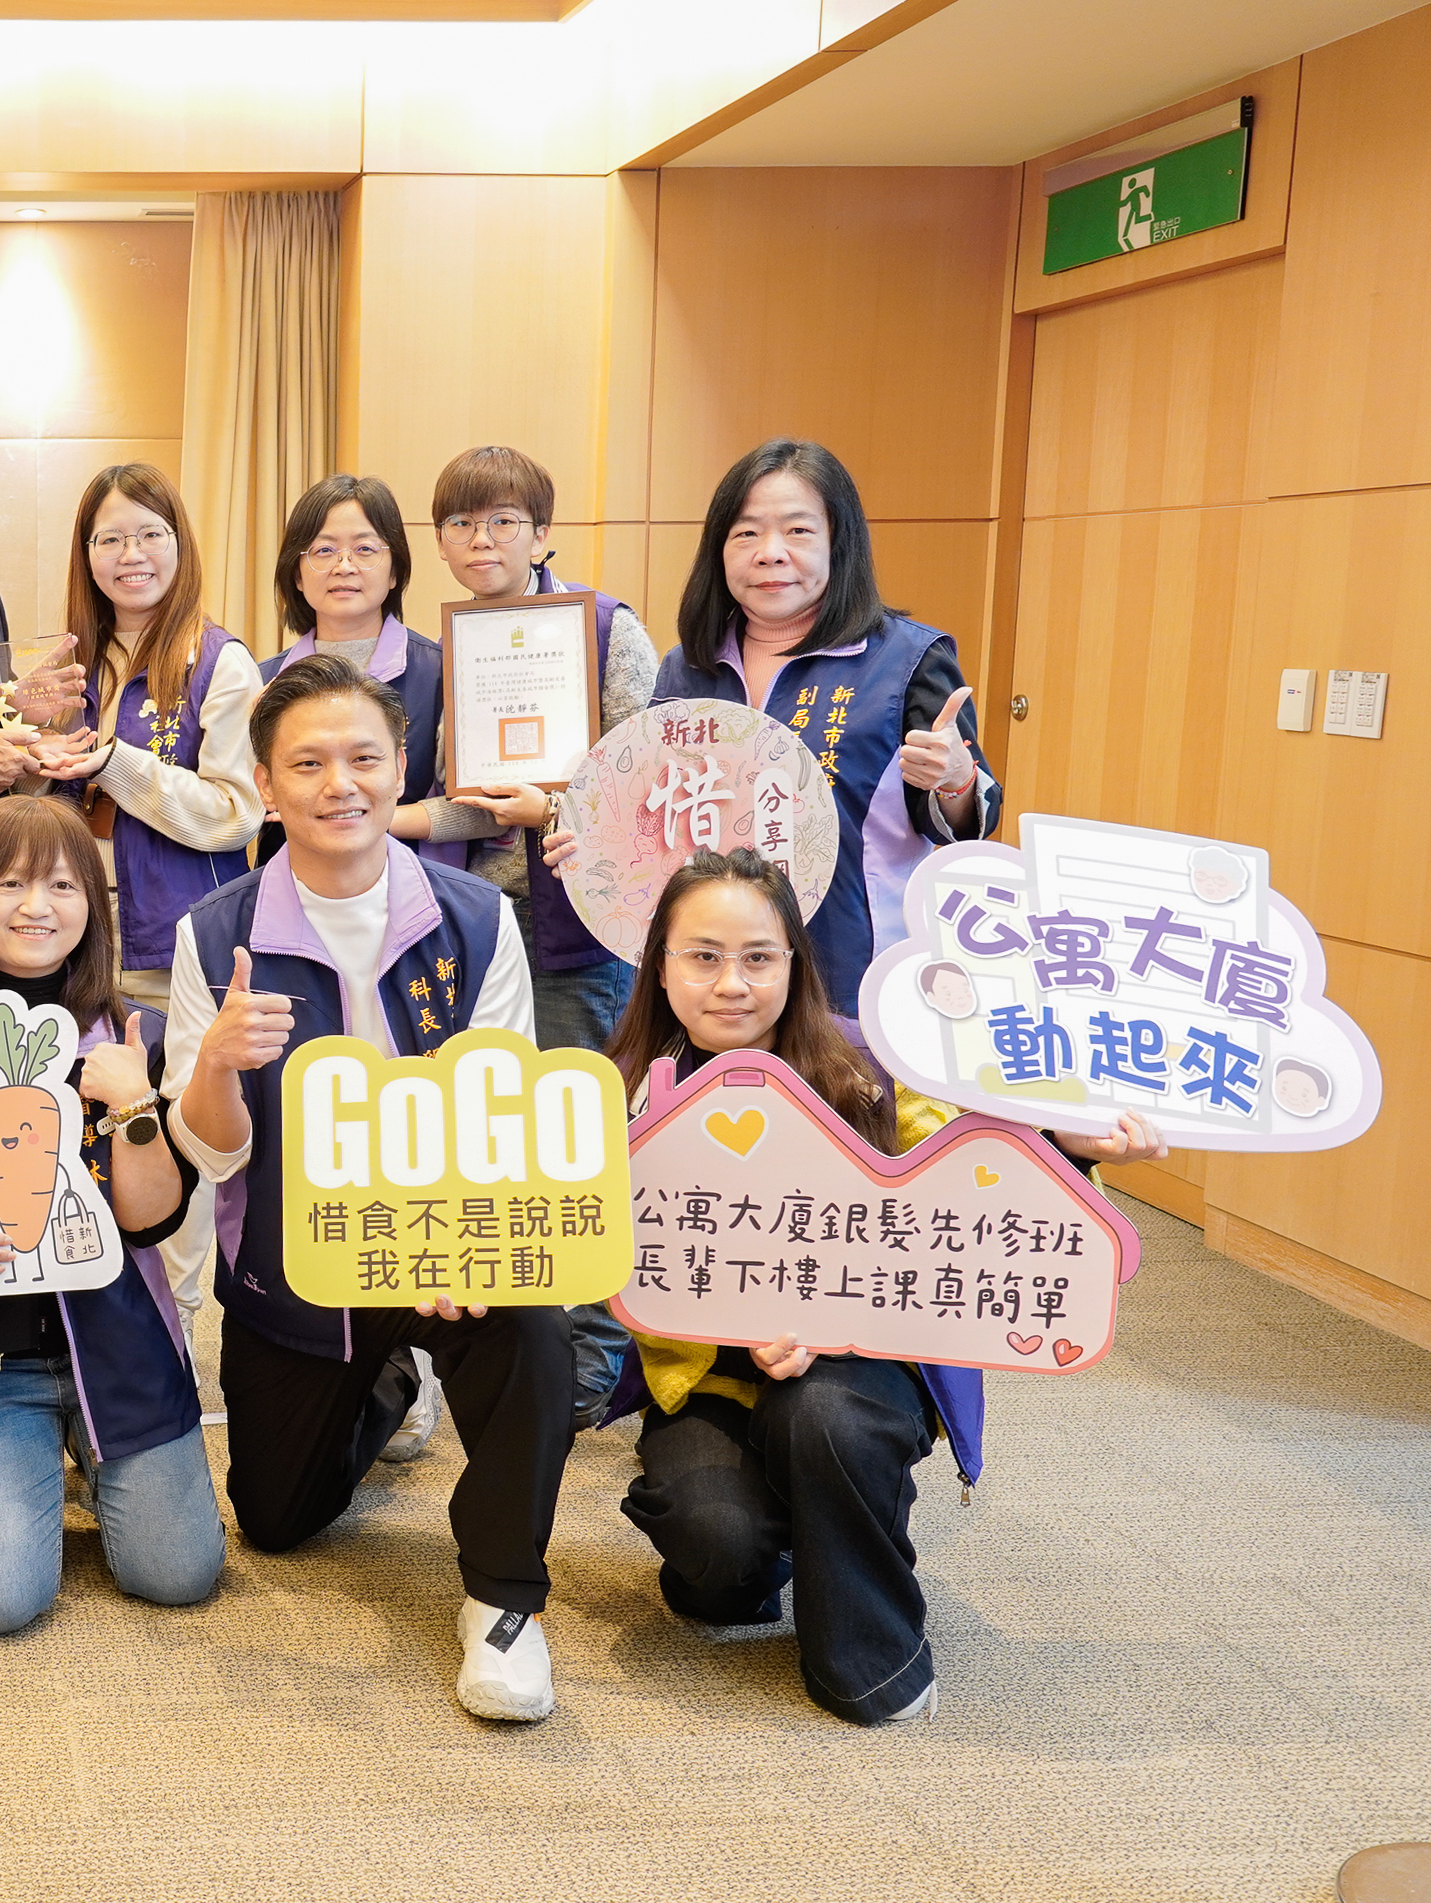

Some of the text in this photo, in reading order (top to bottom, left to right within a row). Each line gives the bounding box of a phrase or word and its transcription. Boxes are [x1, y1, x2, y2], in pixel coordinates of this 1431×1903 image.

[1153, 225, 1179, 242] EXIT
[661, 717, 720, 748] 新北
[788, 685, 819, 737] 副局
[935, 885, 1297, 1032] 公寓大廈
[408, 976, 442, 1034] 科長
[987, 1004, 1264, 1117] 動起來
[303, 1047, 606, 1190] GoGo
[307, 1194, 606, 1244] 惜食不是說說
[633, 1185, 1085, 1258] 公寓大廈銀髮先修班
[357, 1245, 555, 1291] 我在行動
[633, 1243, 1070, 1330] 長輩下樓上課真簡單
